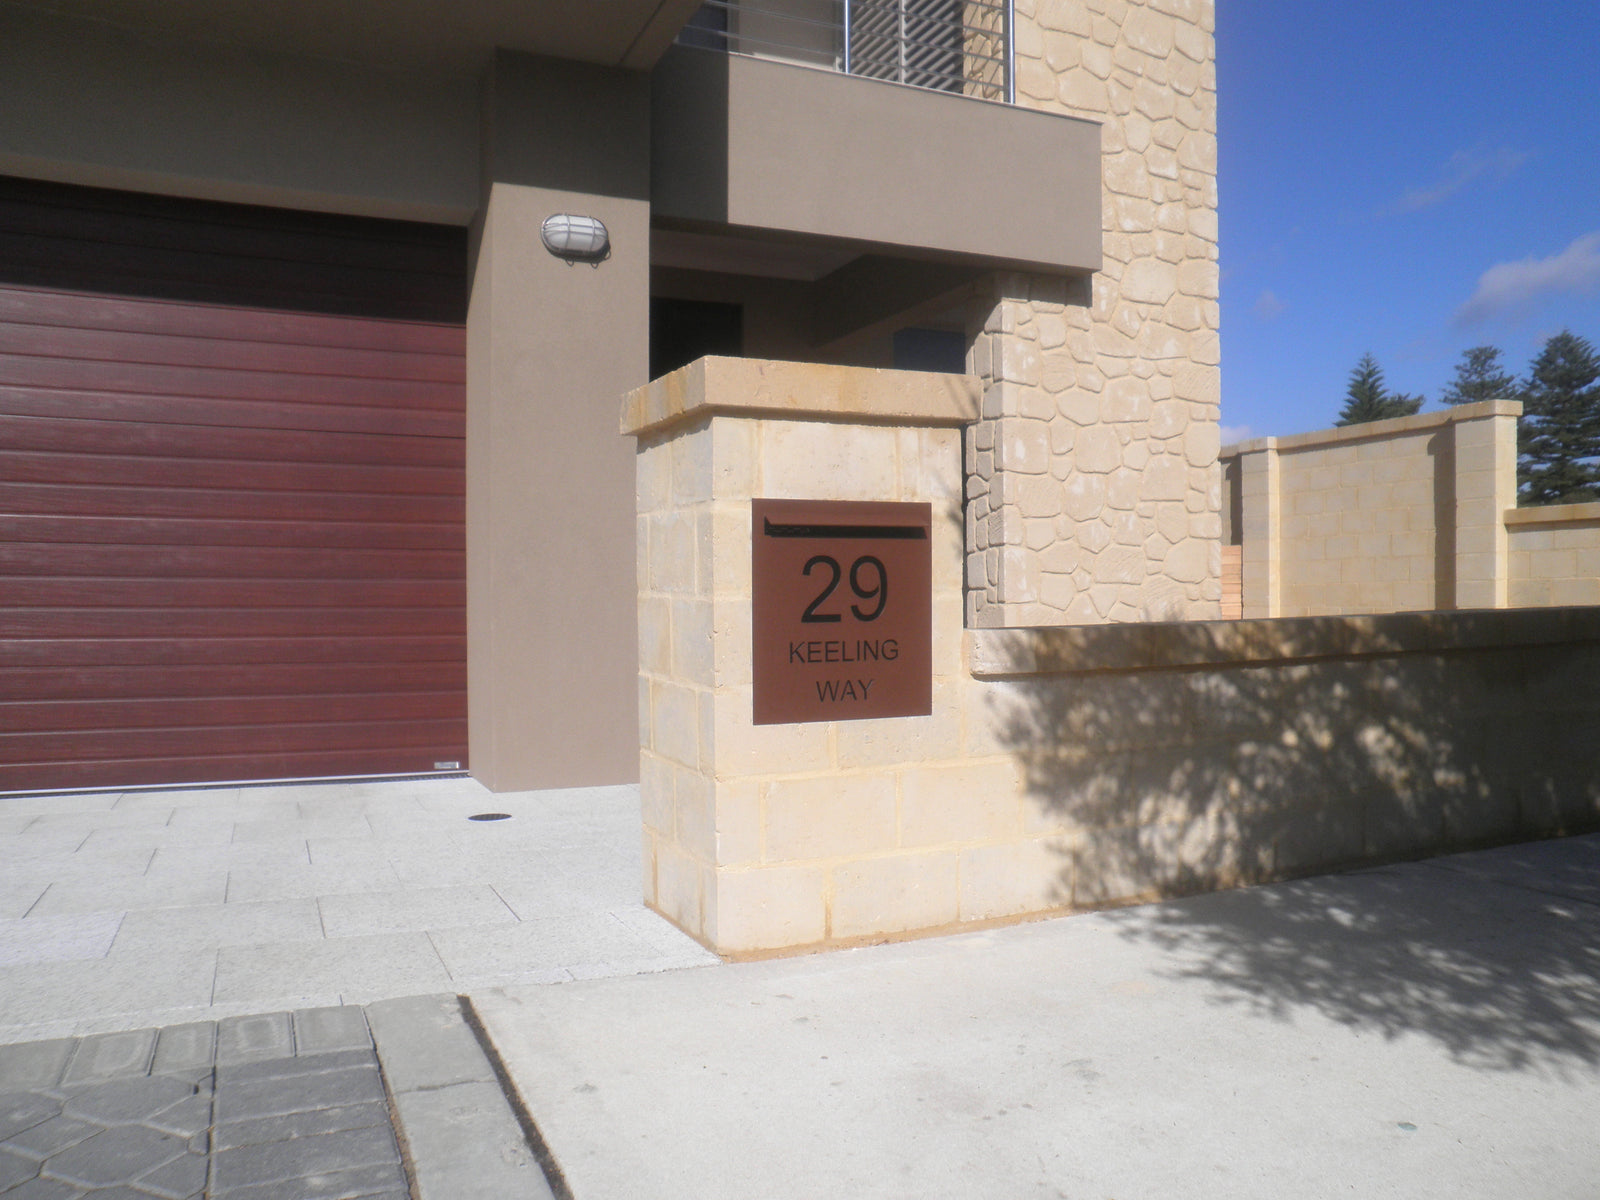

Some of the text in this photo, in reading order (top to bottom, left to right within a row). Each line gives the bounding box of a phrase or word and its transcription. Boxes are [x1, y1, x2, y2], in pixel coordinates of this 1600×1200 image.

[800, 555, 888, 623] 29
[789, 639, 899, 664] KEELING
[816, 679, 874, 702] WAY
